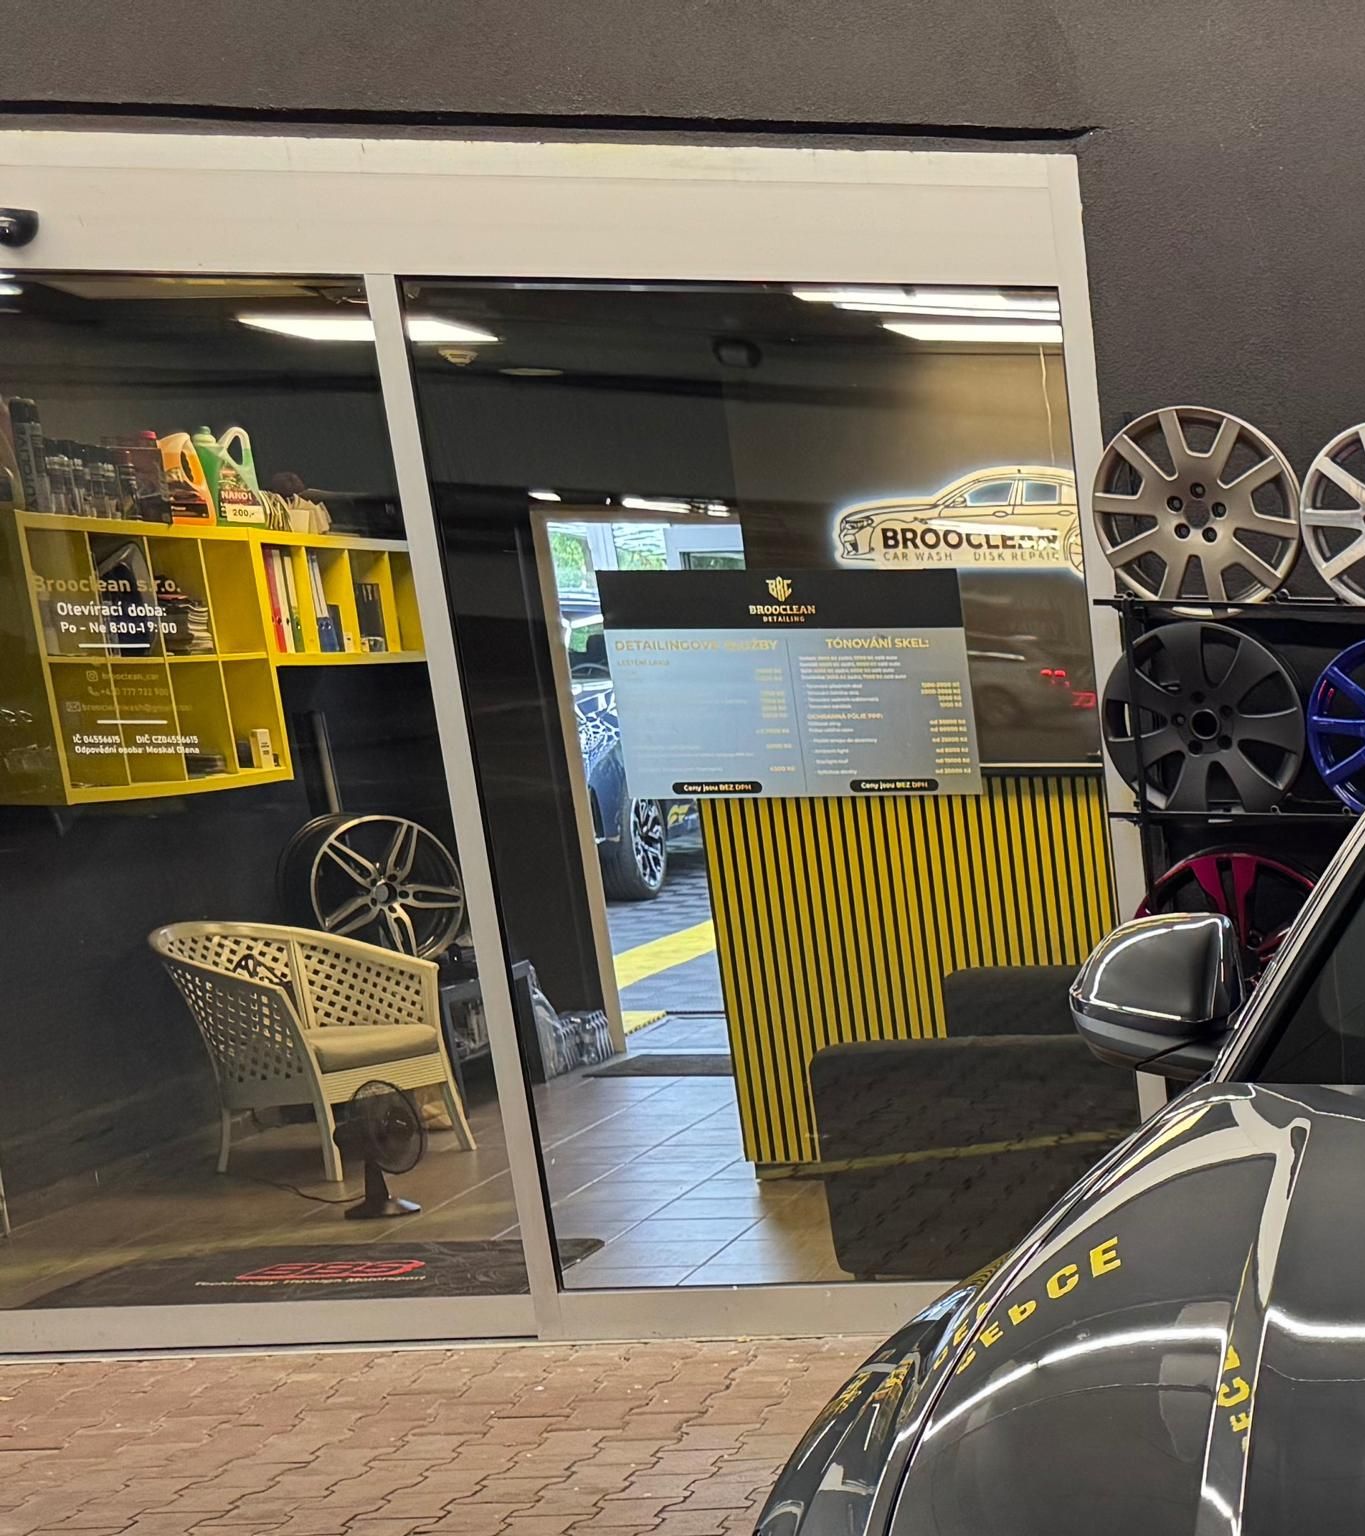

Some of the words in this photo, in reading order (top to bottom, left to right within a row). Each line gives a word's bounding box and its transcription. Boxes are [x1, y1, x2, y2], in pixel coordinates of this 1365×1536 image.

[883, 551, 909, 562] CAR
[916, 551, 953, 562] WASH
[974, 551, 1005, 562] DISK
[33, 575, 131, 593] Brooclean
[137, 577, 181, 593] s.r.o.
[57, 601, 123, 617] Otevírací
[128, 603, 168, 617] doba:
[748, 604, 816, 615] BROOCLEAN
[762, 615, 806, 623] DETAILING
[60, 622, 77, 633] Po
[90, 622, 106, 633] Ne
